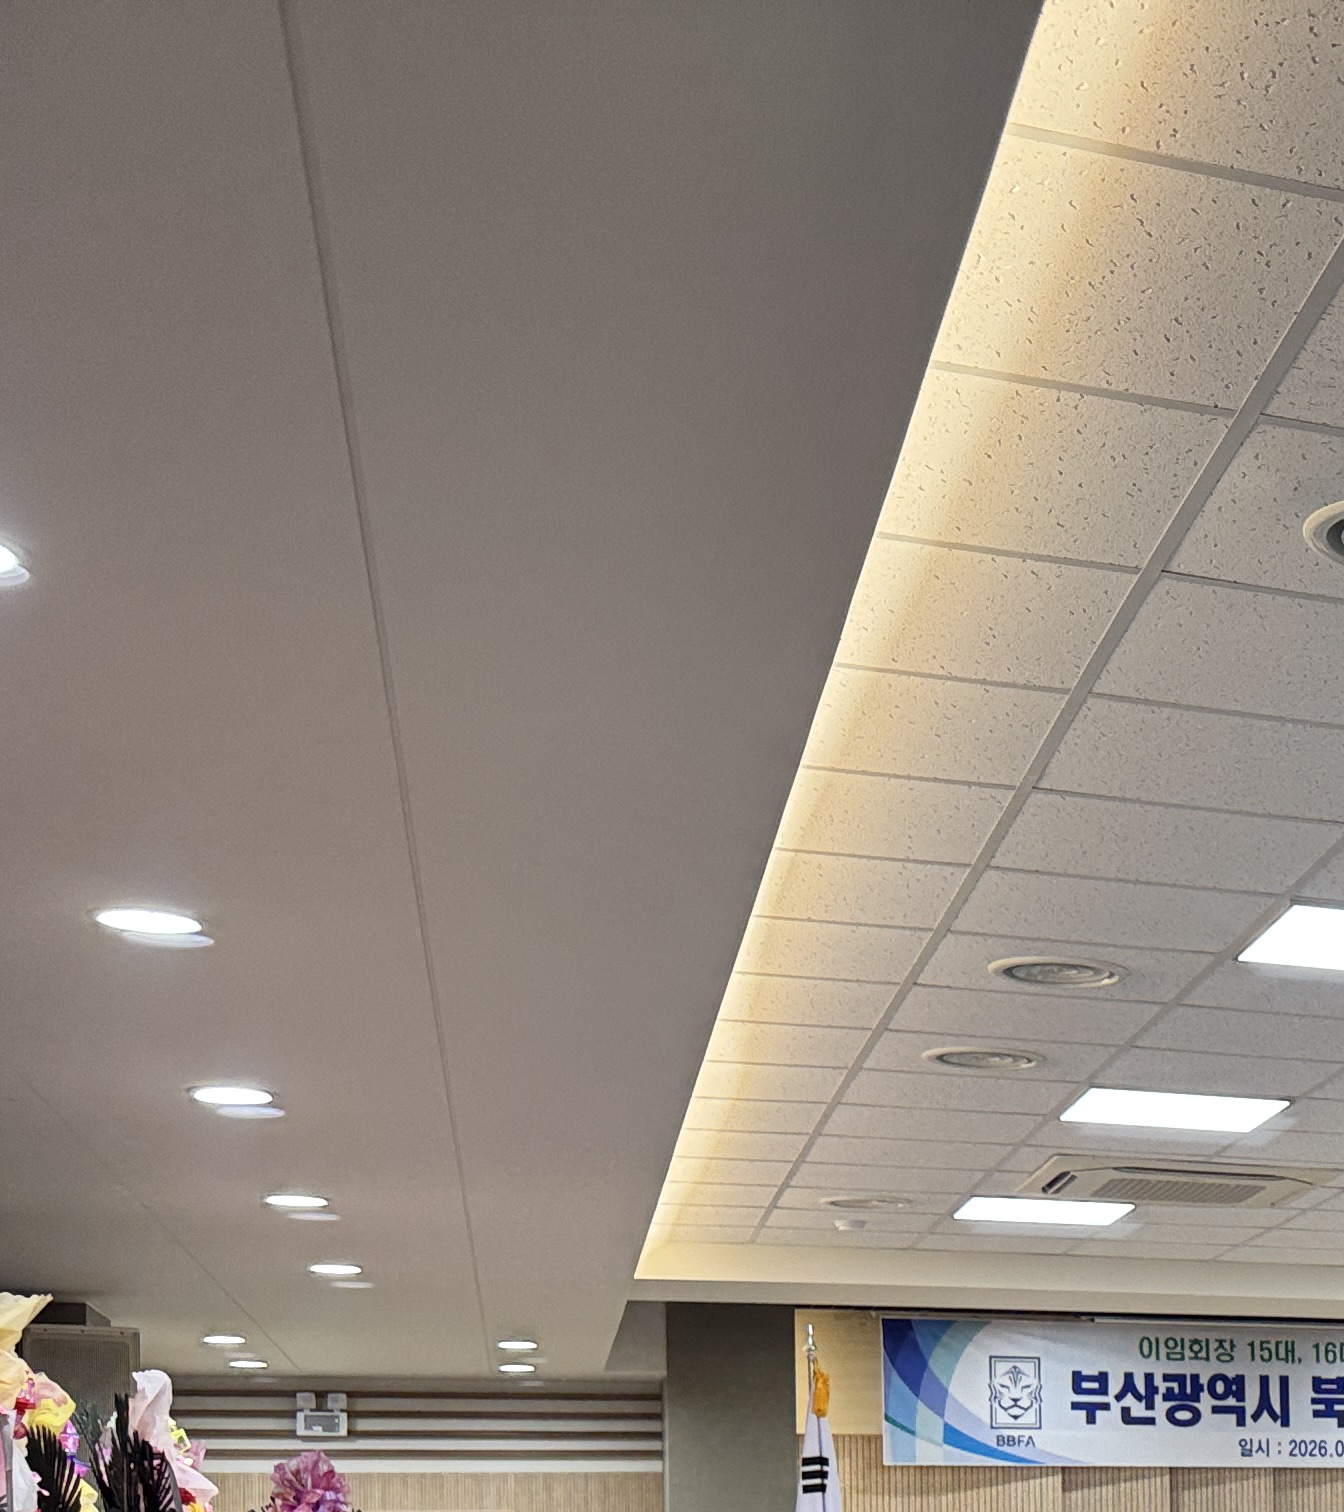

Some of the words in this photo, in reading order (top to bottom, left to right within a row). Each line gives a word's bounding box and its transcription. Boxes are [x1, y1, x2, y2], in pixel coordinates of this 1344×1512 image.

[1139, 1336, 1236, 1363] 이임회장
[1070, 1370, 1290, 1427] 부산광역시
[996, 1435, 1035, 1448] BBFA
[1238, 1438, 1270, 1458] 일시
